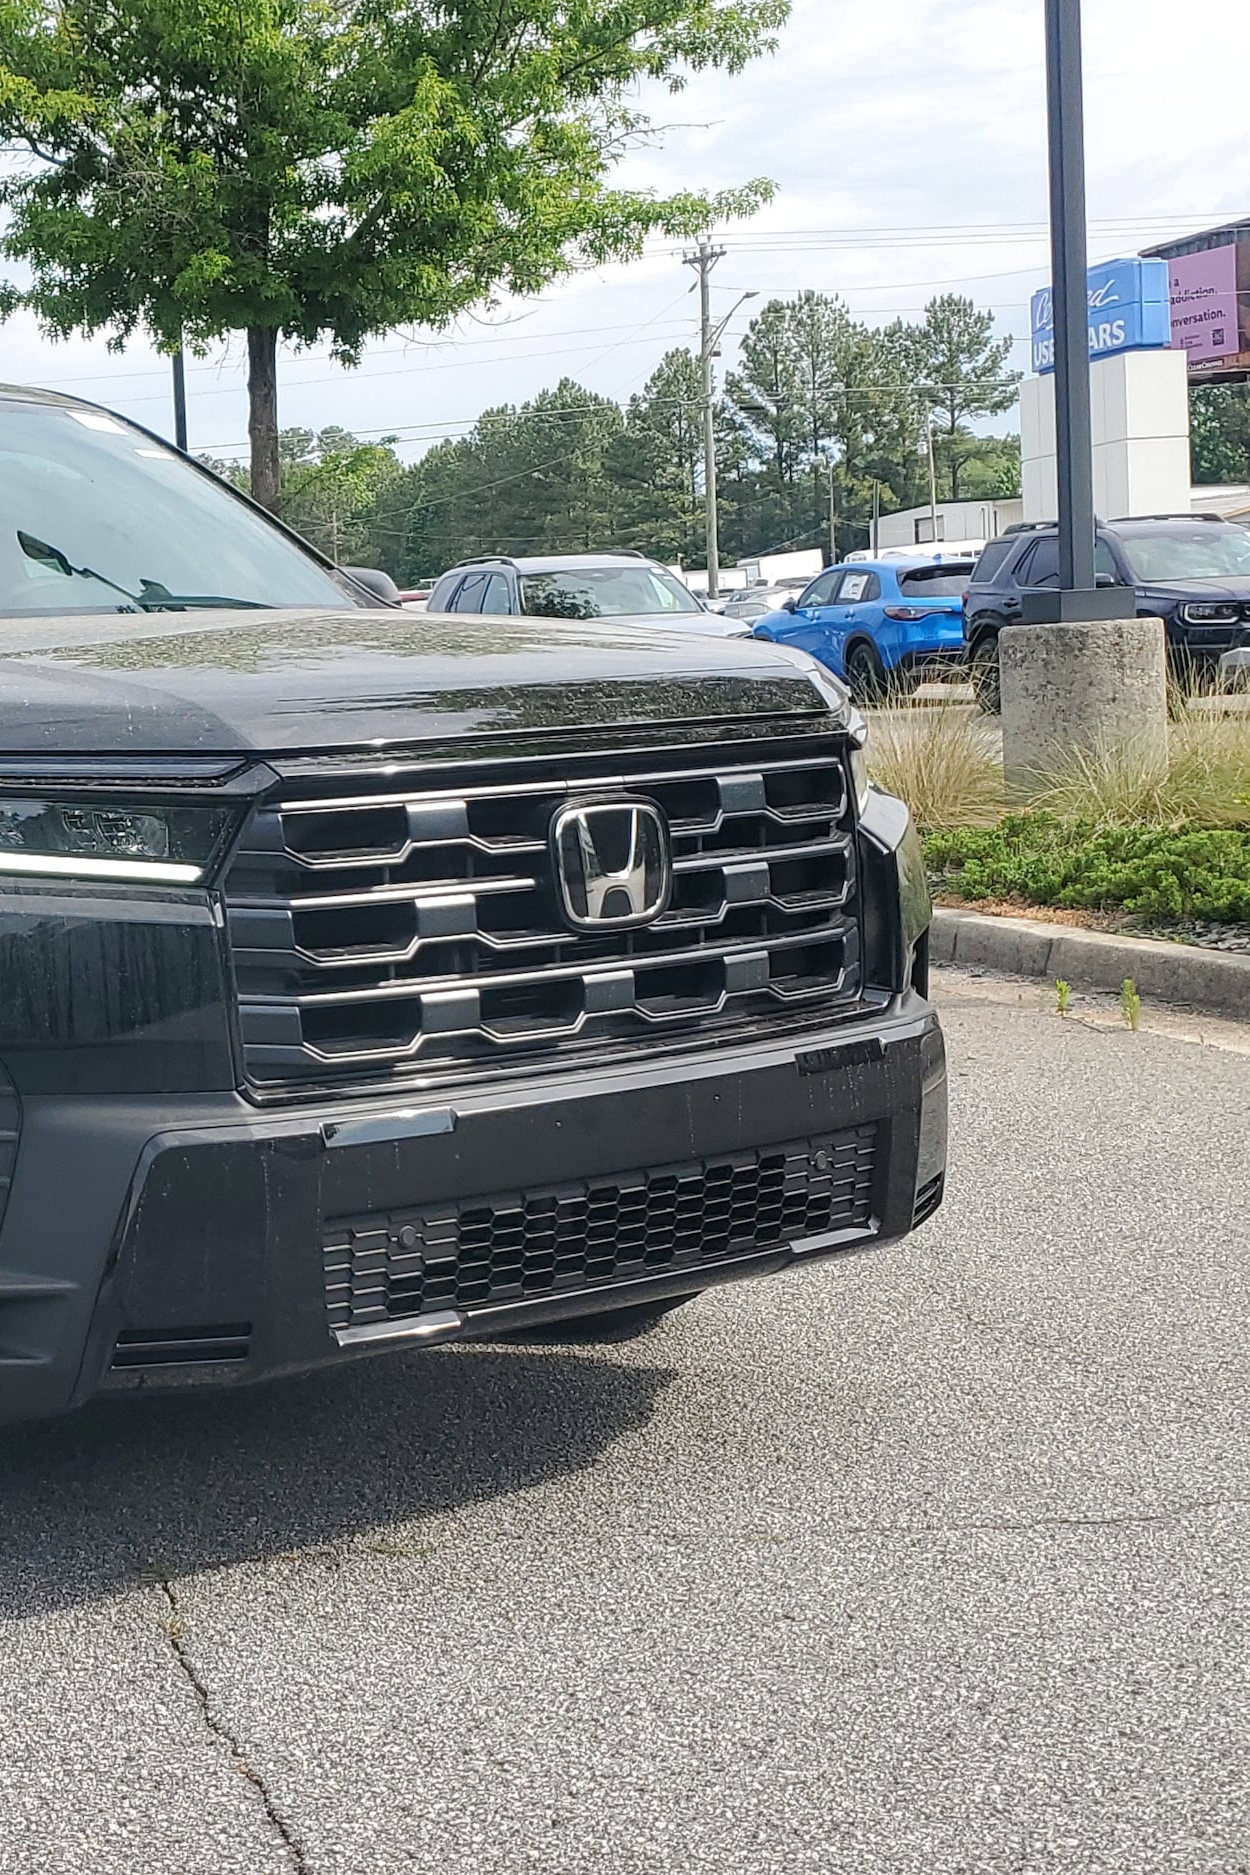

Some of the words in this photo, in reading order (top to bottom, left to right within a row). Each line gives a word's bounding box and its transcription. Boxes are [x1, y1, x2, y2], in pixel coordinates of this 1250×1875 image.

[1171, 309, 1226, 328] nversation.
[1034, 339, 1055, 367] USE
[1087, 319, 1126, 350] ARS
